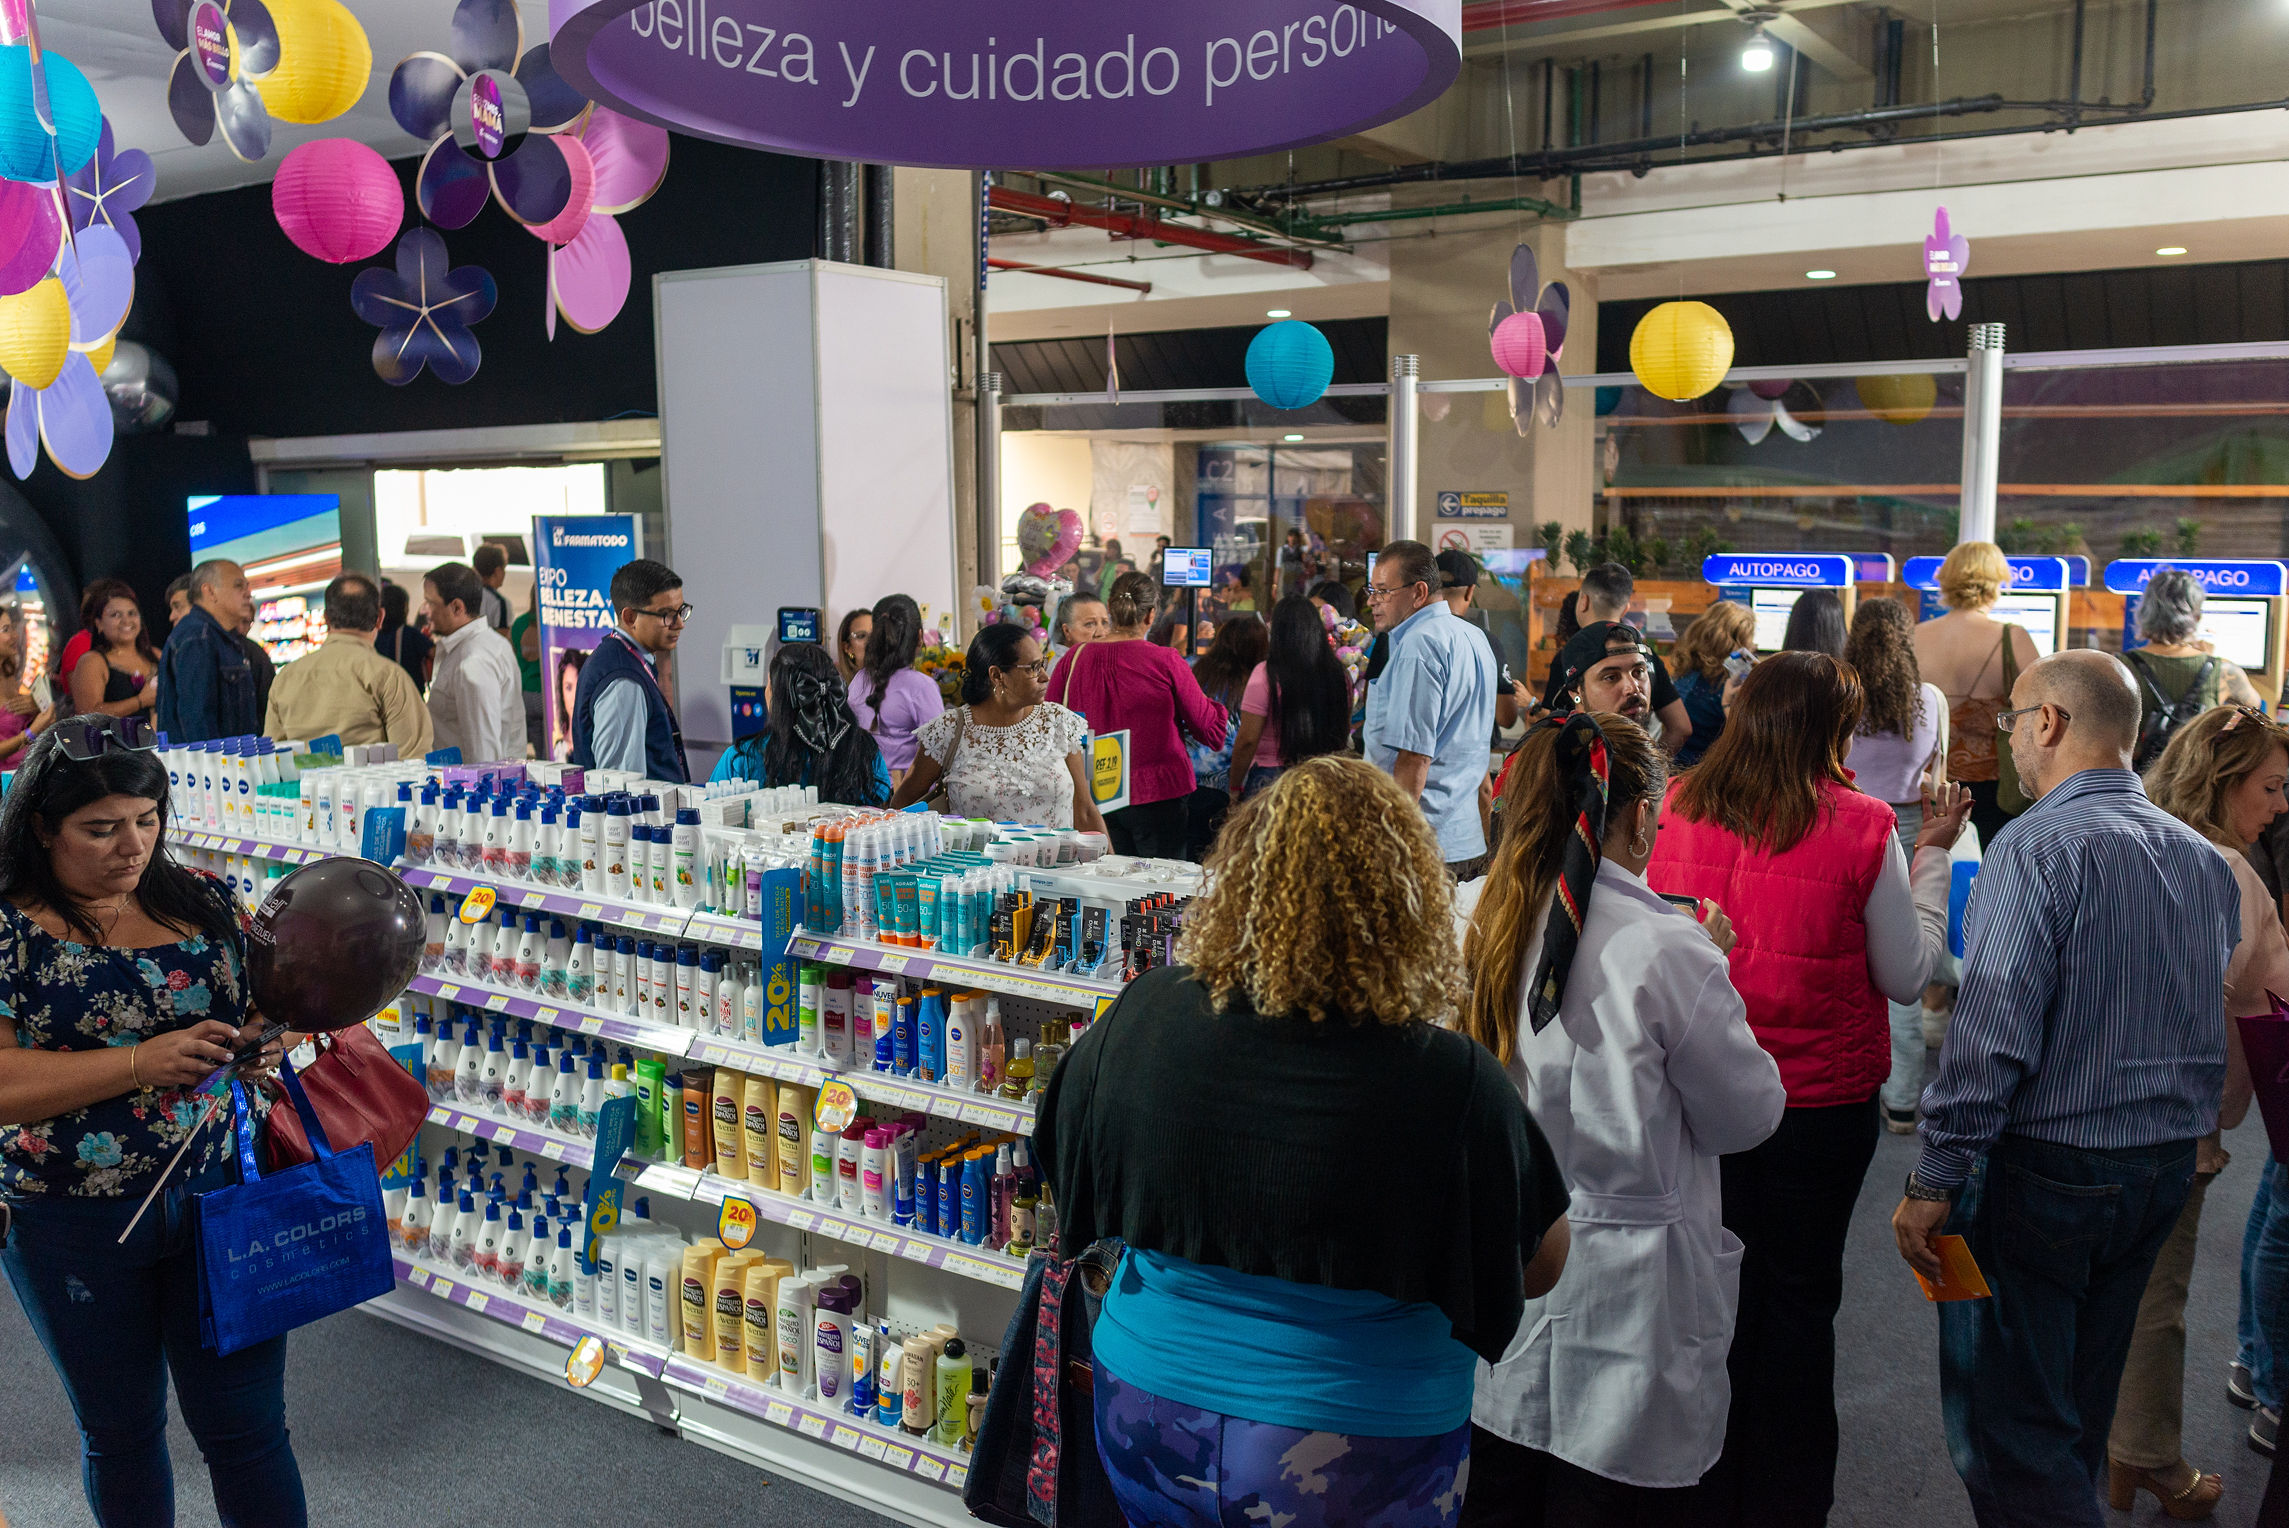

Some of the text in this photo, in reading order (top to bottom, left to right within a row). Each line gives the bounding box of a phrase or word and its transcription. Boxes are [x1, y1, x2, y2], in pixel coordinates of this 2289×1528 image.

[838, 41, 876, 107] y
[899, 33, 1180, 101] cuidado
[1463, 494, 1506, 506] Taquilla
[1462, 506, 1506, 516] prepago
[564, 535, 628, 547] FARMATODO
[1728, 562, 1820, 578] AUTOPAGO
[716, 1122, 736, 1132] Avena
[747, 1132, 765, 1142] Avena
[780, 1140, 798, 1150] Avena
[228, 1206, 366, 1262] L.A. COLORS
[257, 1256, 350, 1295] WWW.LACOLORS.COM
[684, 1303, 703, 1314] Avena
[717, 1303, 742, 1312] ESPAÑOL
[719, 1315, 740, 1325] Avena
[747, 1325, 765, 1336] Avena
[817, 1337, 840, 1347] ESPAÑOL
[1033, 1337, 1058, 1434] BEAR
